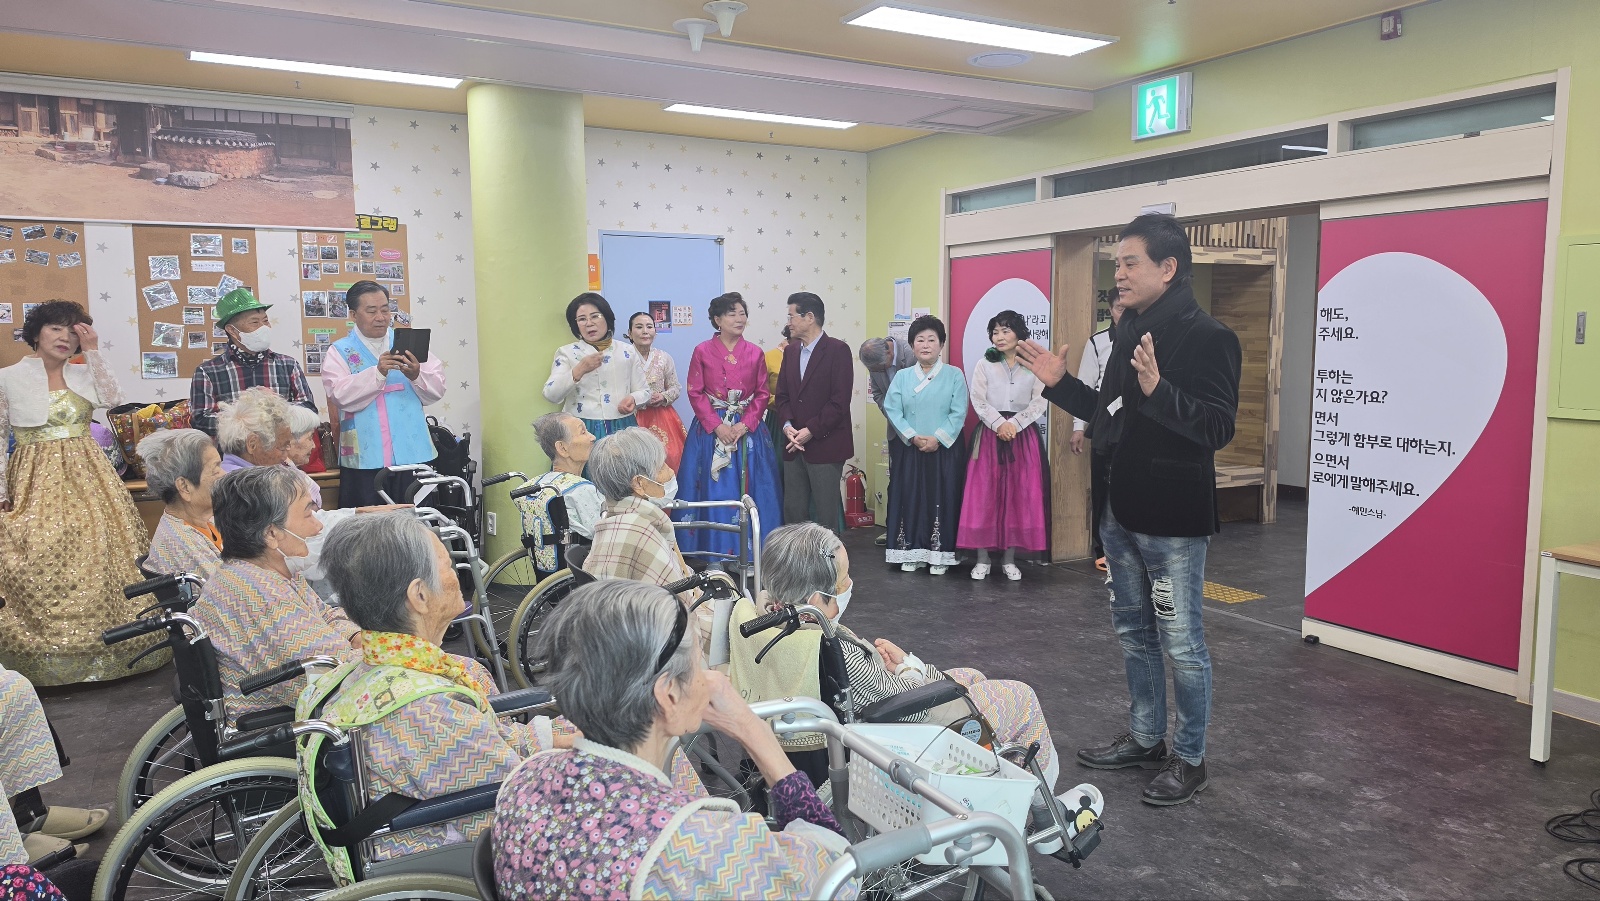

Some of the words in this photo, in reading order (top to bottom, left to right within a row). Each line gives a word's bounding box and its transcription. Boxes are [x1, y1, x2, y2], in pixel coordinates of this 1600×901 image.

[1319, 307, 1349, 323] 해도,
[1317, 326, 1359, 342] 주세요.
[1315, 369, 1354, 385] 투하는
[1315, 388, 1328, 403] 지
[1330, 388, 1389, 405] 않은가요?
[1314, 410, 1339, 427] 면서
[1313, 429, 1351, 447] 그렇게
[1352, 432, 1393, 450] 함부로
[1396, 436, 1456, 457] 대하는지.
[1312, 452, 1350, 471] 으면서
[1311, 471, 1349, 489] 로에게
[1350, 475, 1420, 497] 말해주세요.
